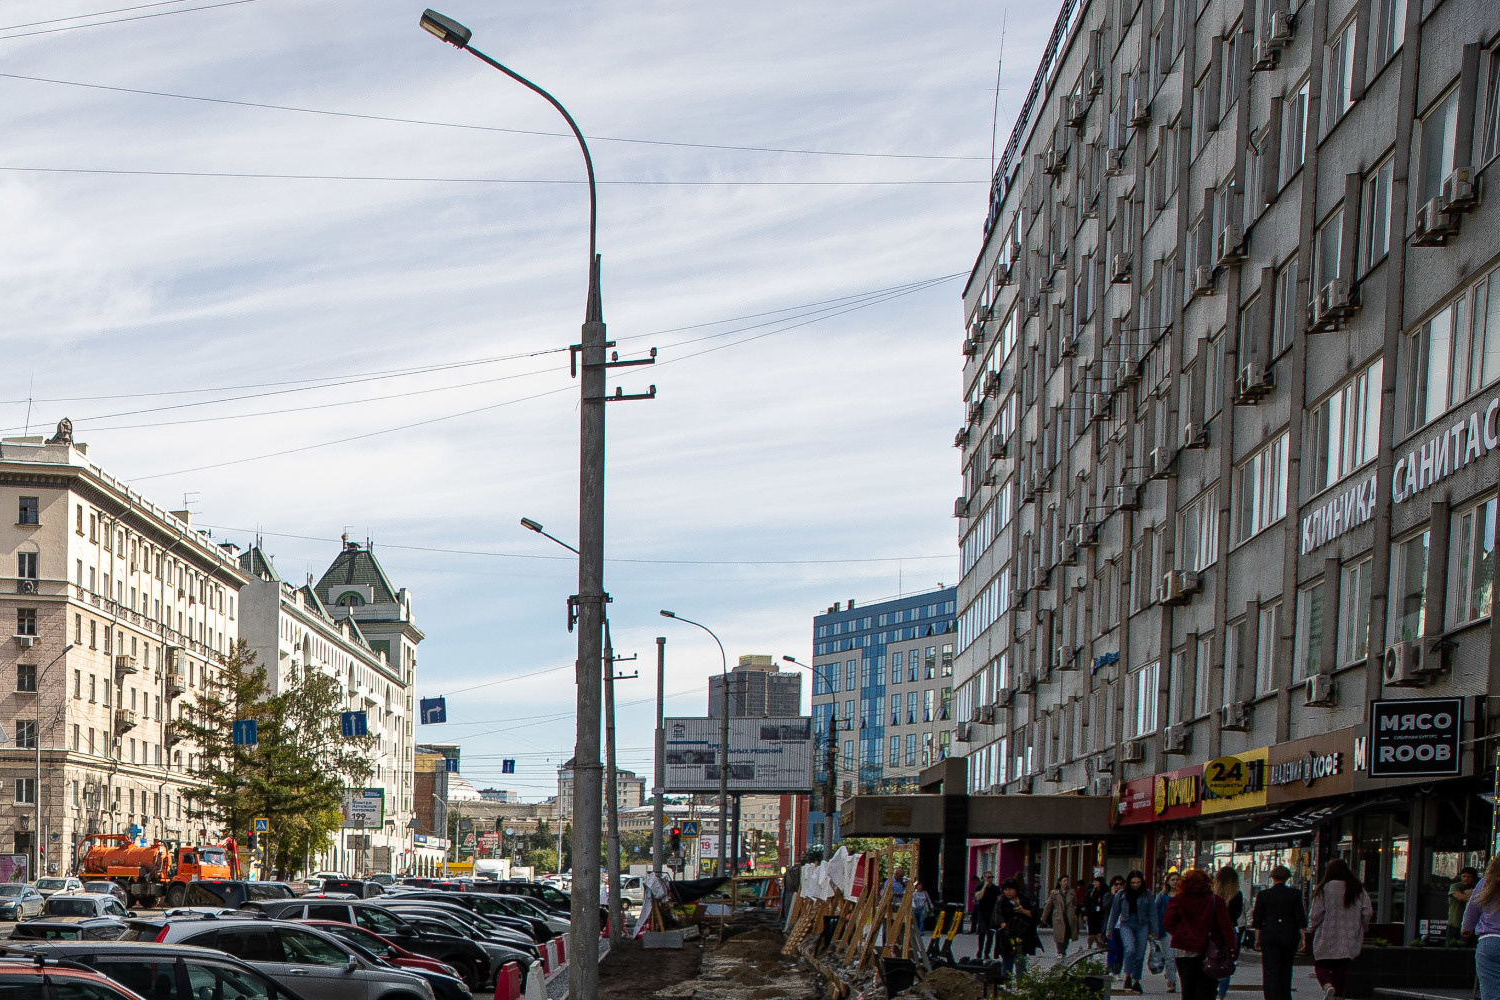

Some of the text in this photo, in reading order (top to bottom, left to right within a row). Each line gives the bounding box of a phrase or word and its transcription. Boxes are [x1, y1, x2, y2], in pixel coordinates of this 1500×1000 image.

[1302, 397, 1499, 556] КЛИНИКА САНИТАС
[1380, 712, 1452, 732] МЯСО
[1379, 743, 1451, 763] ROOB
[1211, 762, 1243, 782] 24
[1312, 752, 1339, 779] КОФЕ
